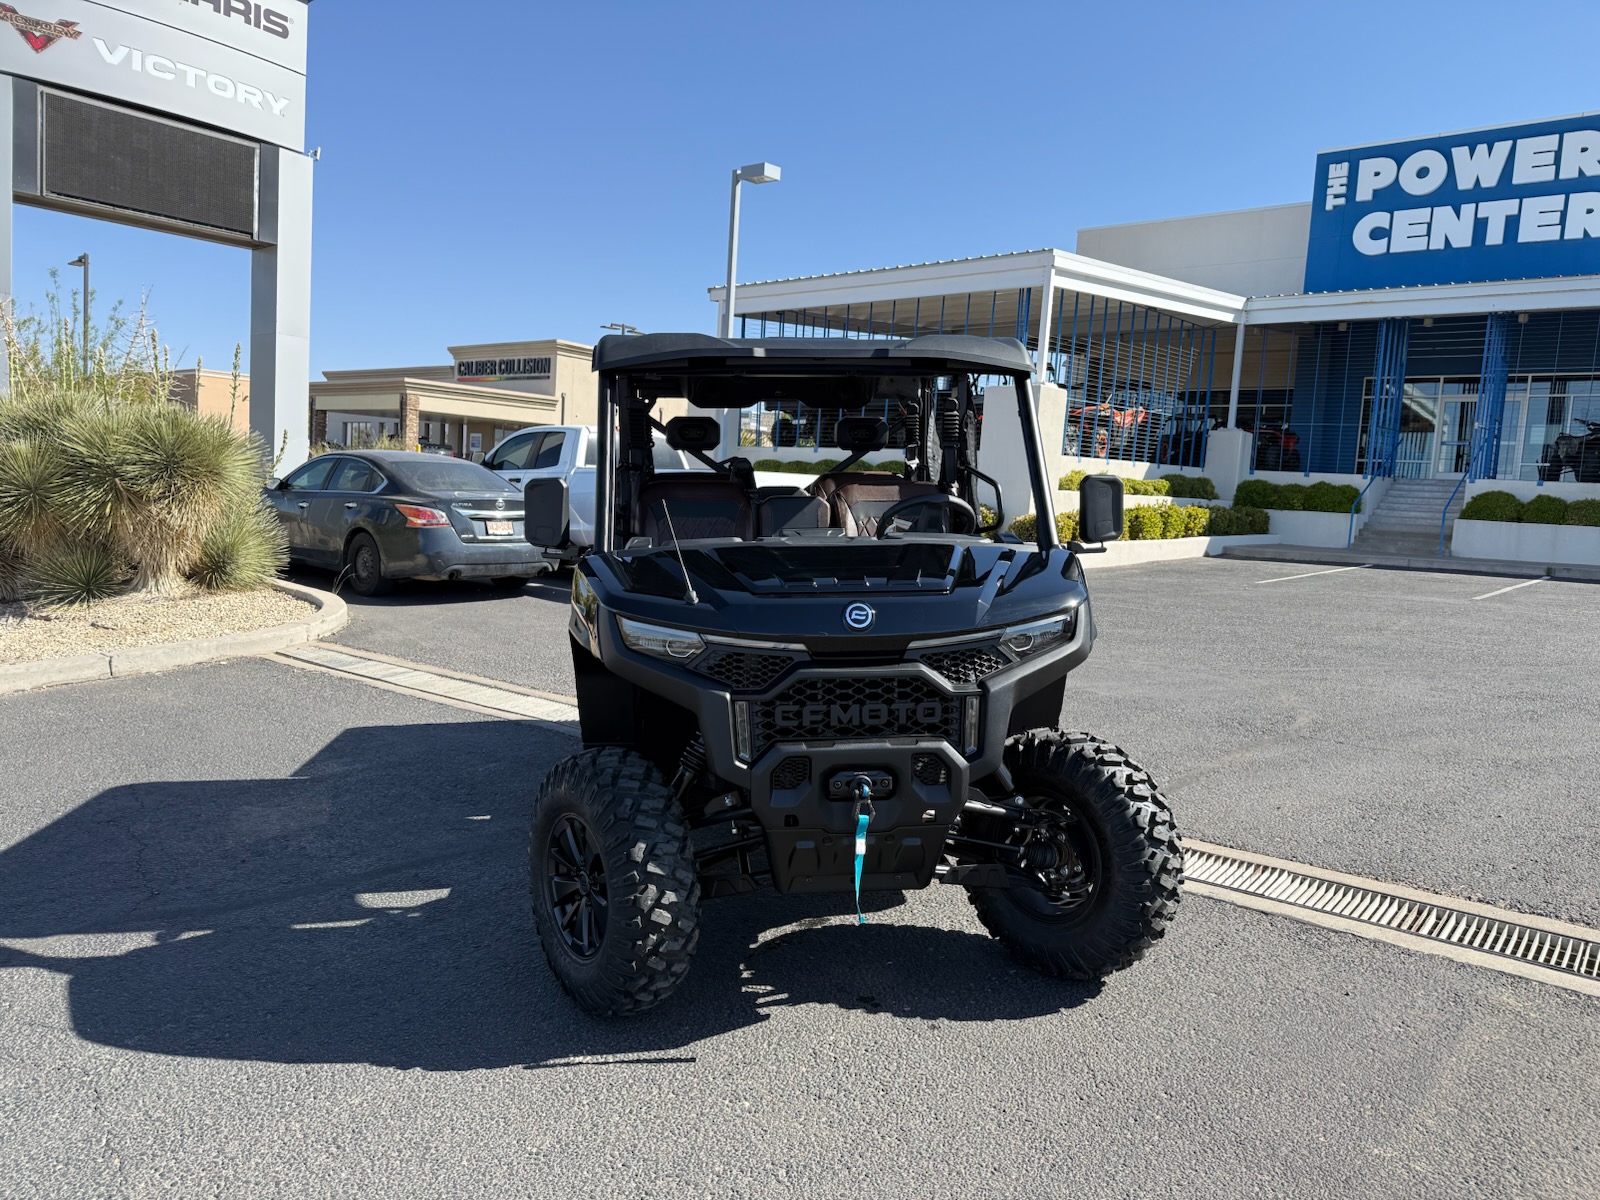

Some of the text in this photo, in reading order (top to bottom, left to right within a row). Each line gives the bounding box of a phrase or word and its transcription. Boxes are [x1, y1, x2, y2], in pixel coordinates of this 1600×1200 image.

[92, 37, 290, 116] VICTORY
[1325, 130, 1600, 211] THE POWER
[1352, 191, 1600, 256] CENTER
[457, 357, 551, 376] CALIBER COLLISION
[774, 702, 942, 726] CFMOTO
